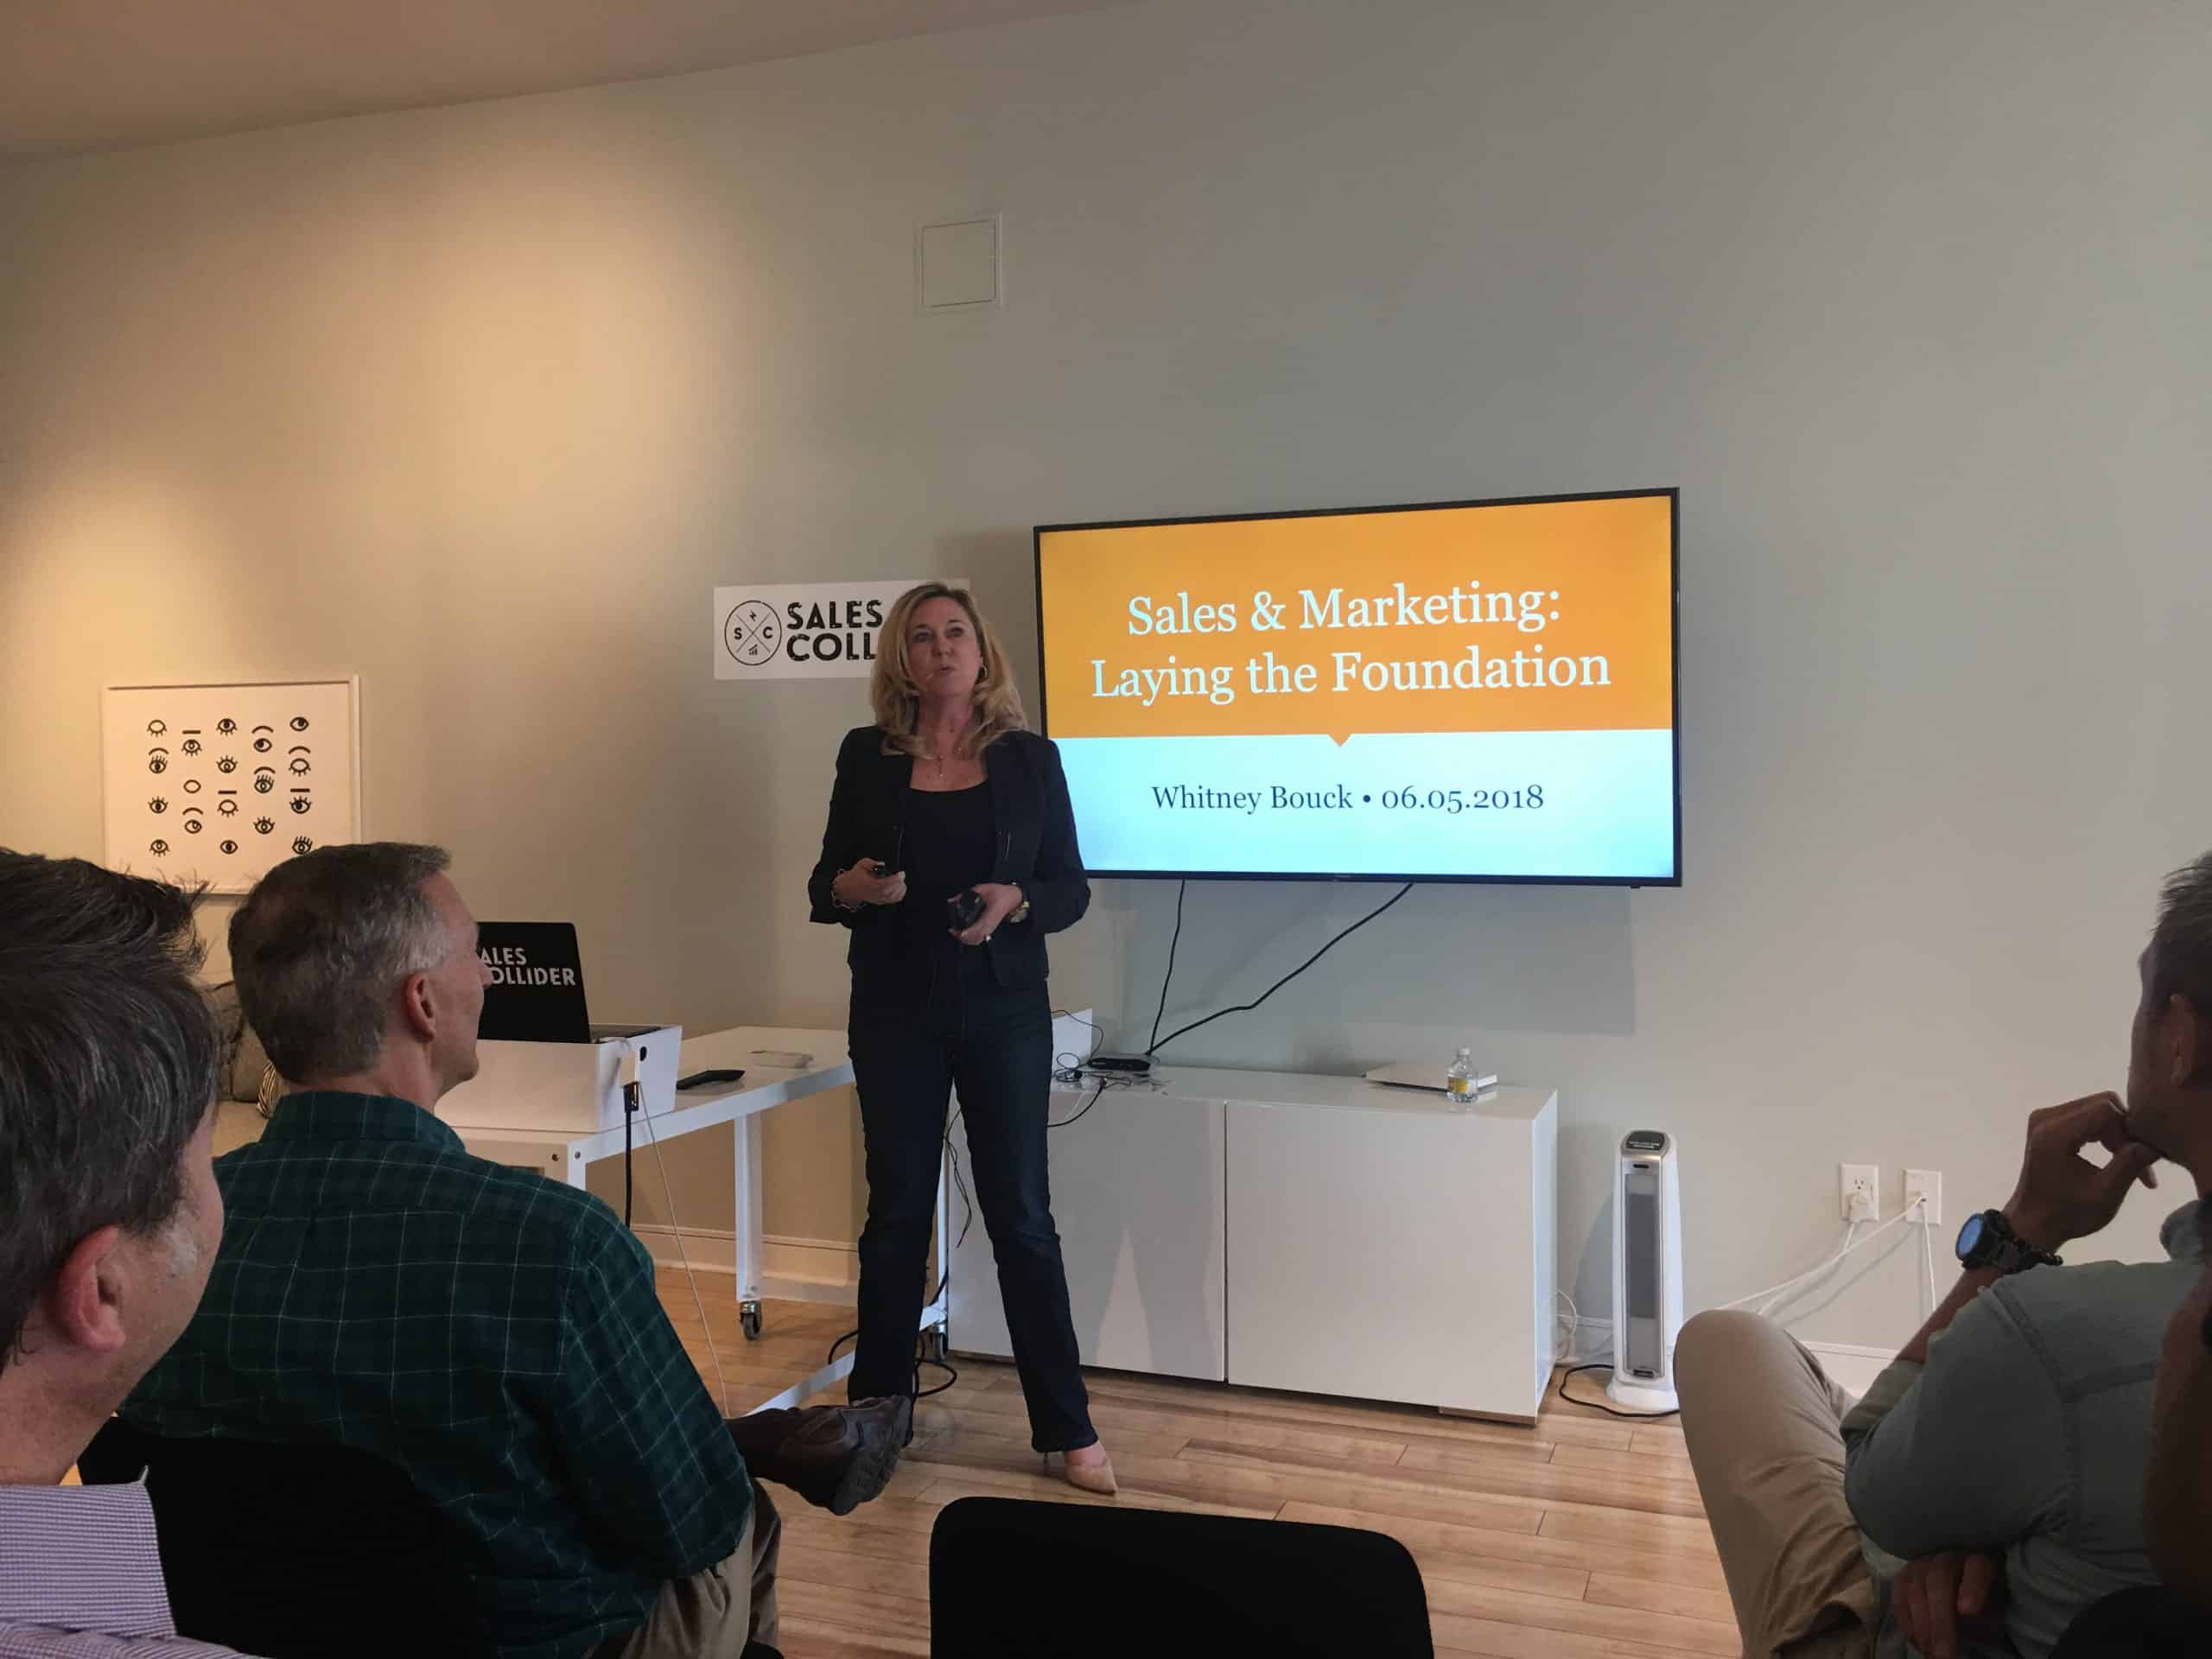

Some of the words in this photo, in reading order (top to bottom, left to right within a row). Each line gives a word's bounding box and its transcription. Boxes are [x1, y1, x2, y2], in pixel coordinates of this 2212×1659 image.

[786, 600, 883, 630] SALES
[1128, 591, 1237, 636] Sales
[1250, 591, 1287, 632] &
[1298, 580, 1560, 633] Marketing:
[734, 627, 743, 640] S
[762, 626, 773, 639] C
[786, 632, 877, 662] COLL
[1091, 655, 1235, 707] Laying
[1245, 651, 1318, 694] the
[1331, 644, 1611, 692] Foundation
[1150, 784, 1262, 816] Whitney
[1269, 783, 1354, 810] Bouck
[1382, 784, 1544, 815] 06.05.2018
[480, 947, 527, 966] ALES
[490, 966, 576, 985] OLLIDER
